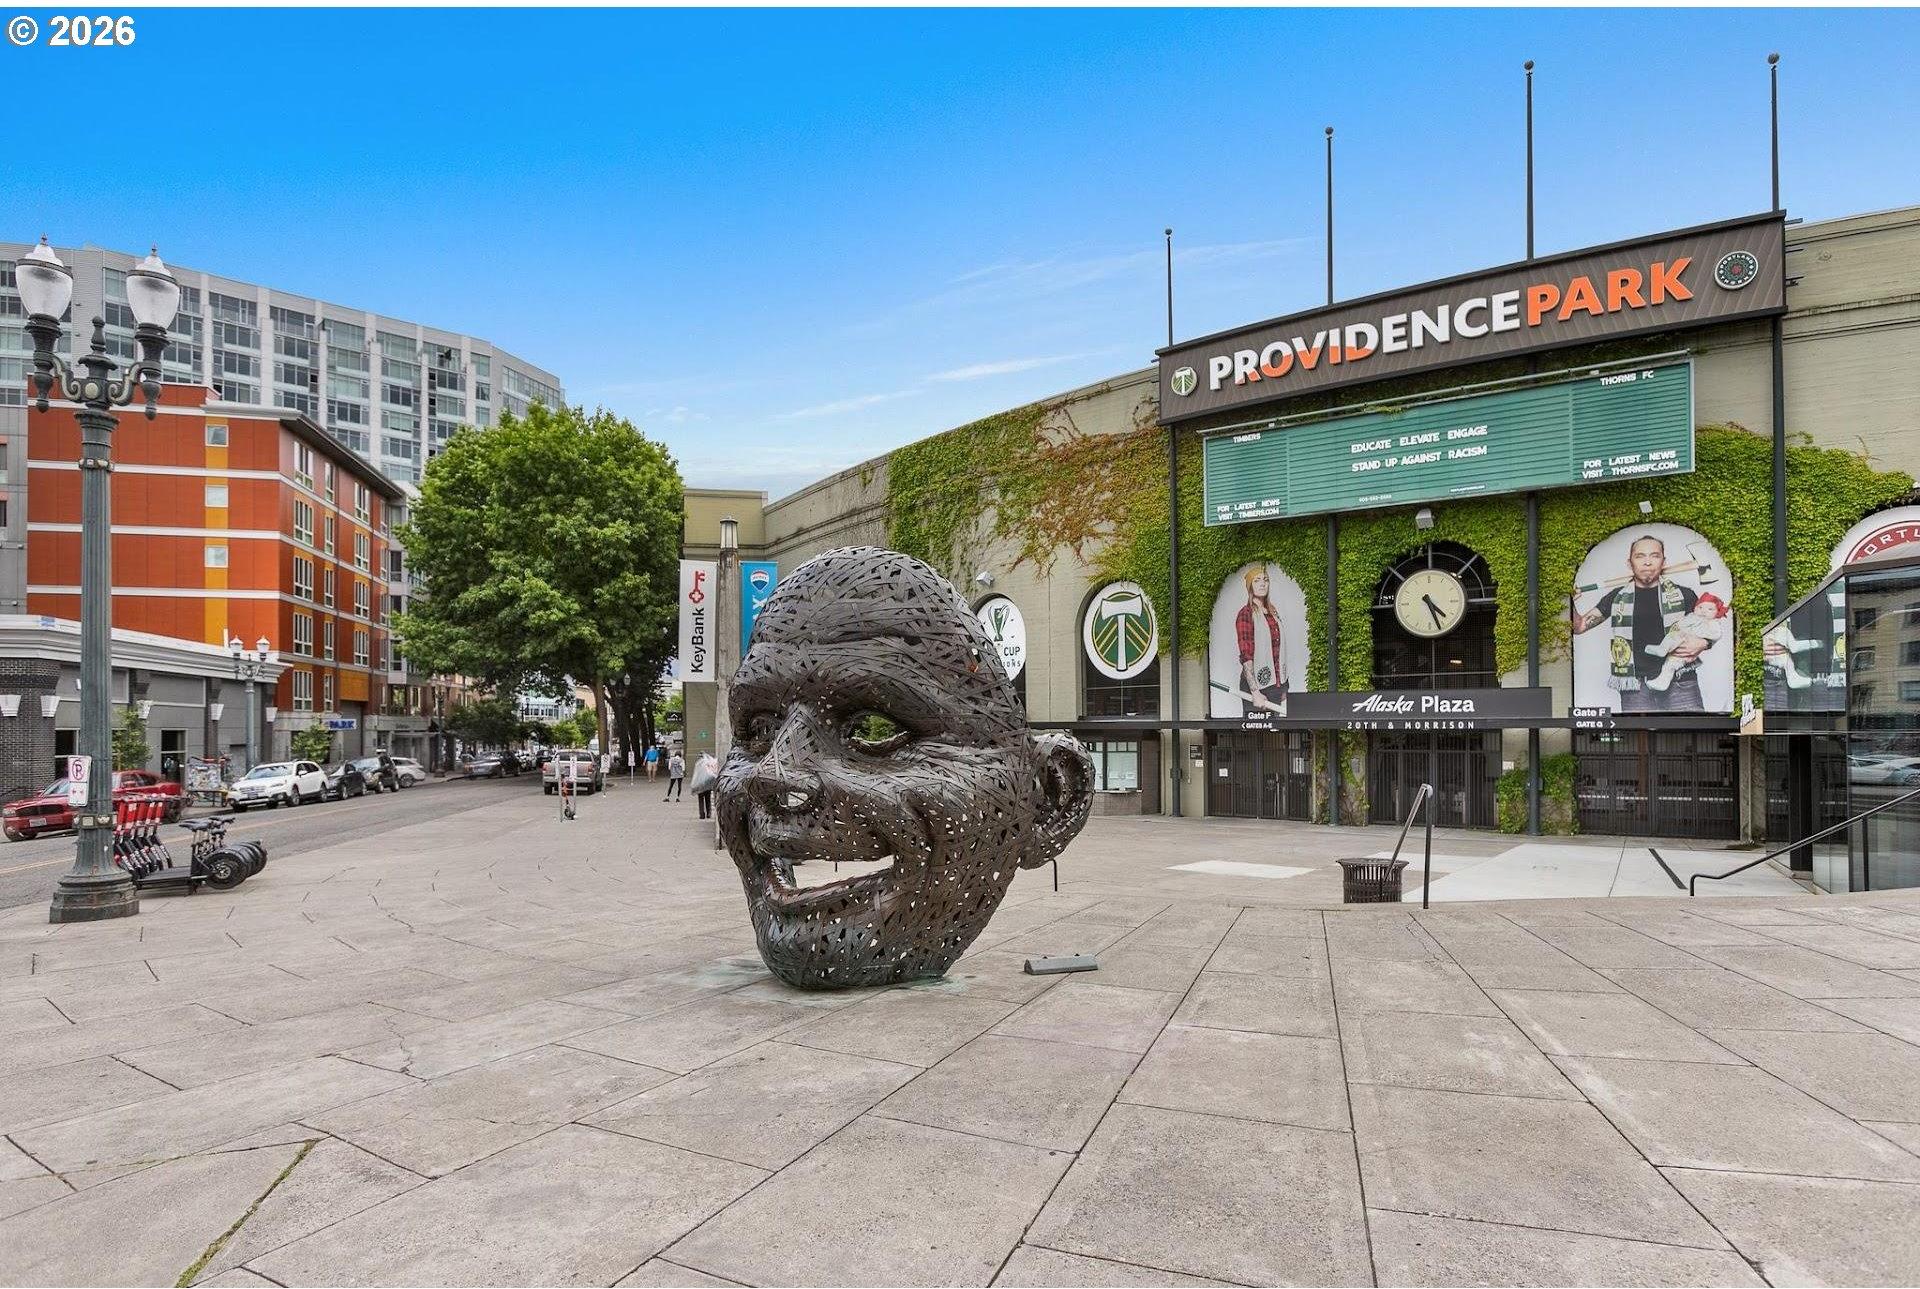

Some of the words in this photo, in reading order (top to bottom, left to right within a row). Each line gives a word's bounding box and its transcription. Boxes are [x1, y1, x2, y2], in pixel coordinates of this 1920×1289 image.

[1209, 289, 1521, 391] PROVIDENCE
[1527, 257, 1694, 327] PARK
[1600, 373, 1637, 385] THORNS
[1642, 370, 1654, 380] FC
[1351, 439, 1392, 453] EDUCATE
[1399, 432, 1440, 446] ELEVATE
[1447, 425, 1488, 440] ENGAGE
[1351, 460, 1381, 472] STAND
[1385, 457, 1398, 467] UP
[1400, 451, 1441, 466] AGAINST
[1447, 445, 1488, 460] RACISM
[1583, 460, 1602, 469] FOR
[1608, 454, 1641, 466] LATEST
[1649, 450, 1676, 461] NEWS
[1582, 468, 1604, 479] VISIT
[1217, 505, 1230, 513] FOR
[1234, 501, 1257, 511] LATEST
[1261, 498, 1280, 507] NEWS
[690, 607, 707, 673] KeyBank
[1003, 646, 1021, 656] CUP
[1352, 694, 1414, 714] Alaska
[1421, 695, 1475, 713] Plaza
[1248, 712, 1264, 720] Gate
[1573, 708, 1597, 717] Gate
[1598, 708, 1606, 717] F
[1347, 721, 1378, 730] 20TH
[1388, 721, 1394, 730] &
[1404, 721, 1475, 730] MORRISON
